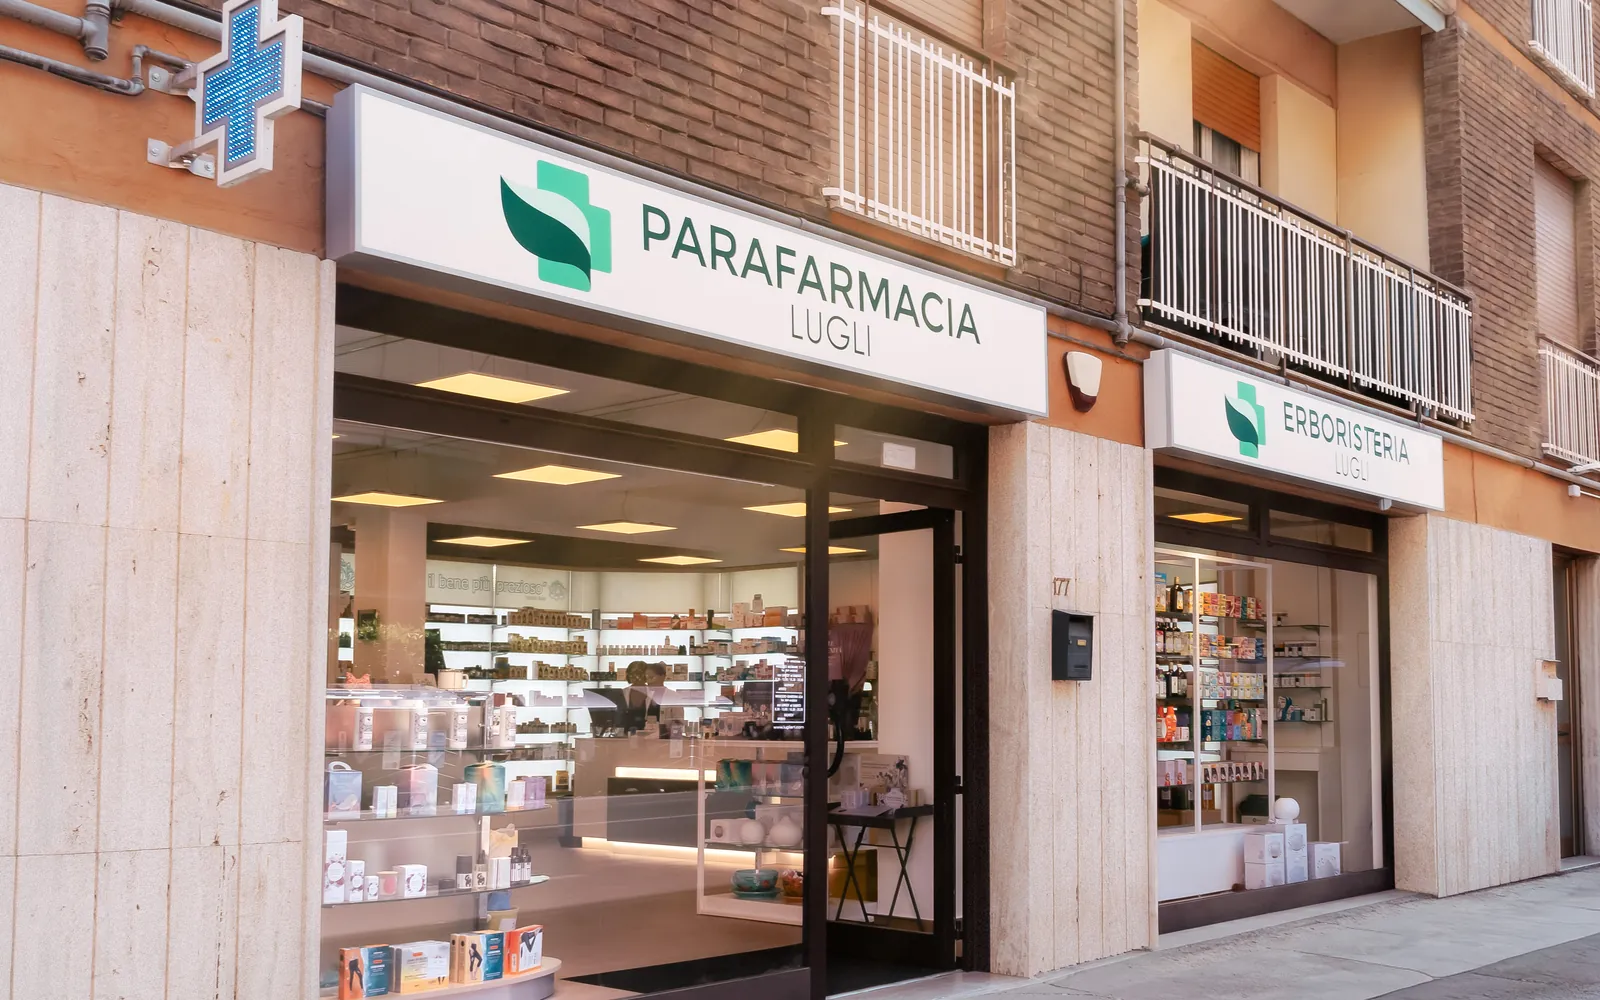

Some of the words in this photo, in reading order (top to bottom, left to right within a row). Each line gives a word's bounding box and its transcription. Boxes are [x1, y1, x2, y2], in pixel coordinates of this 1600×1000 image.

[642, 203, 981, 345] PARAFARMACIA
[791, 304, 871, 357] LUGLI
[1283, 401, 1410, 465] ERBORISTERIA
[1335, 451, 1369, 482] LUGLI
[438, 574, 469, 590] bene
[472, 576, 491, 594] più
[1053, 577, 1071, 596] 177
